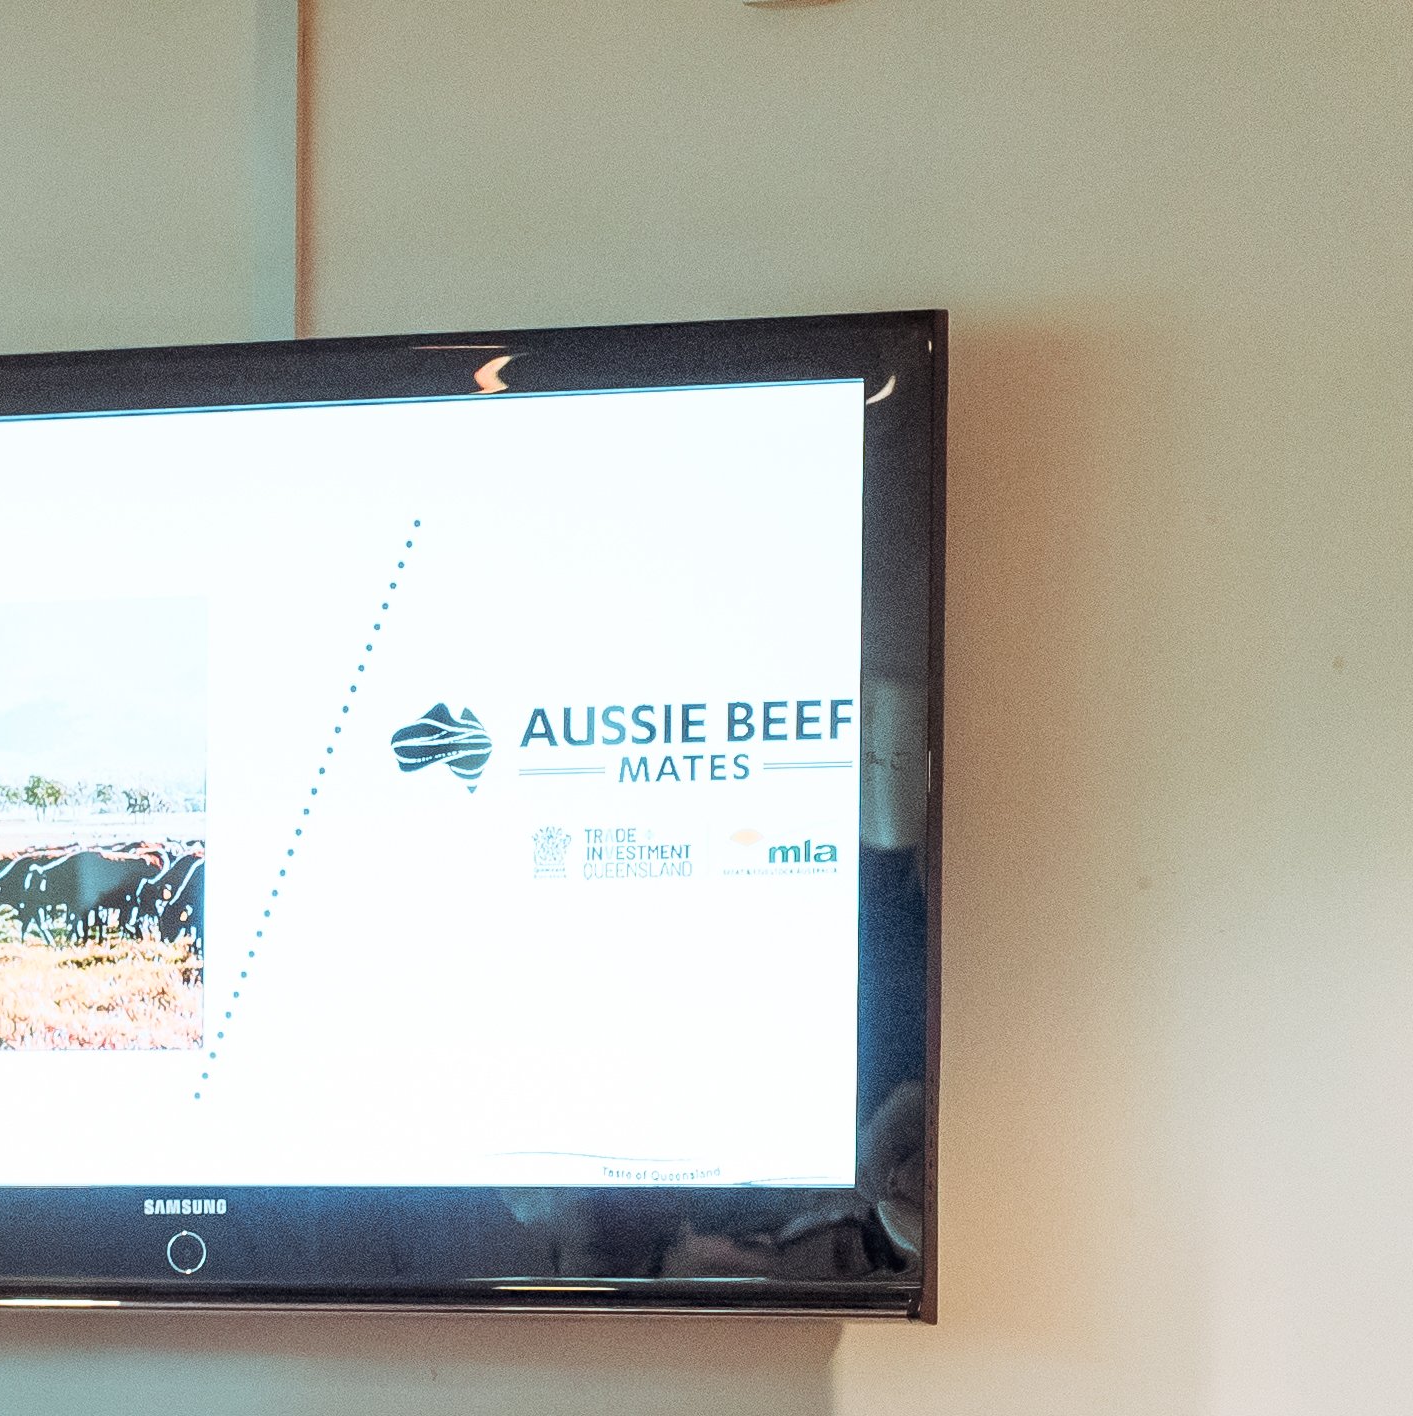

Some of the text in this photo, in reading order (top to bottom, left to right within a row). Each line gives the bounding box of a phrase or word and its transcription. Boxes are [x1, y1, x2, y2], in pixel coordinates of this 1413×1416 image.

[519, 699, 855, 748] AUSSIE BEEF
[618, 753, 751, 784] MATES
[768, 839, 838, 864] mla
[143, 1198, 228, 1216] SAMSUNG
